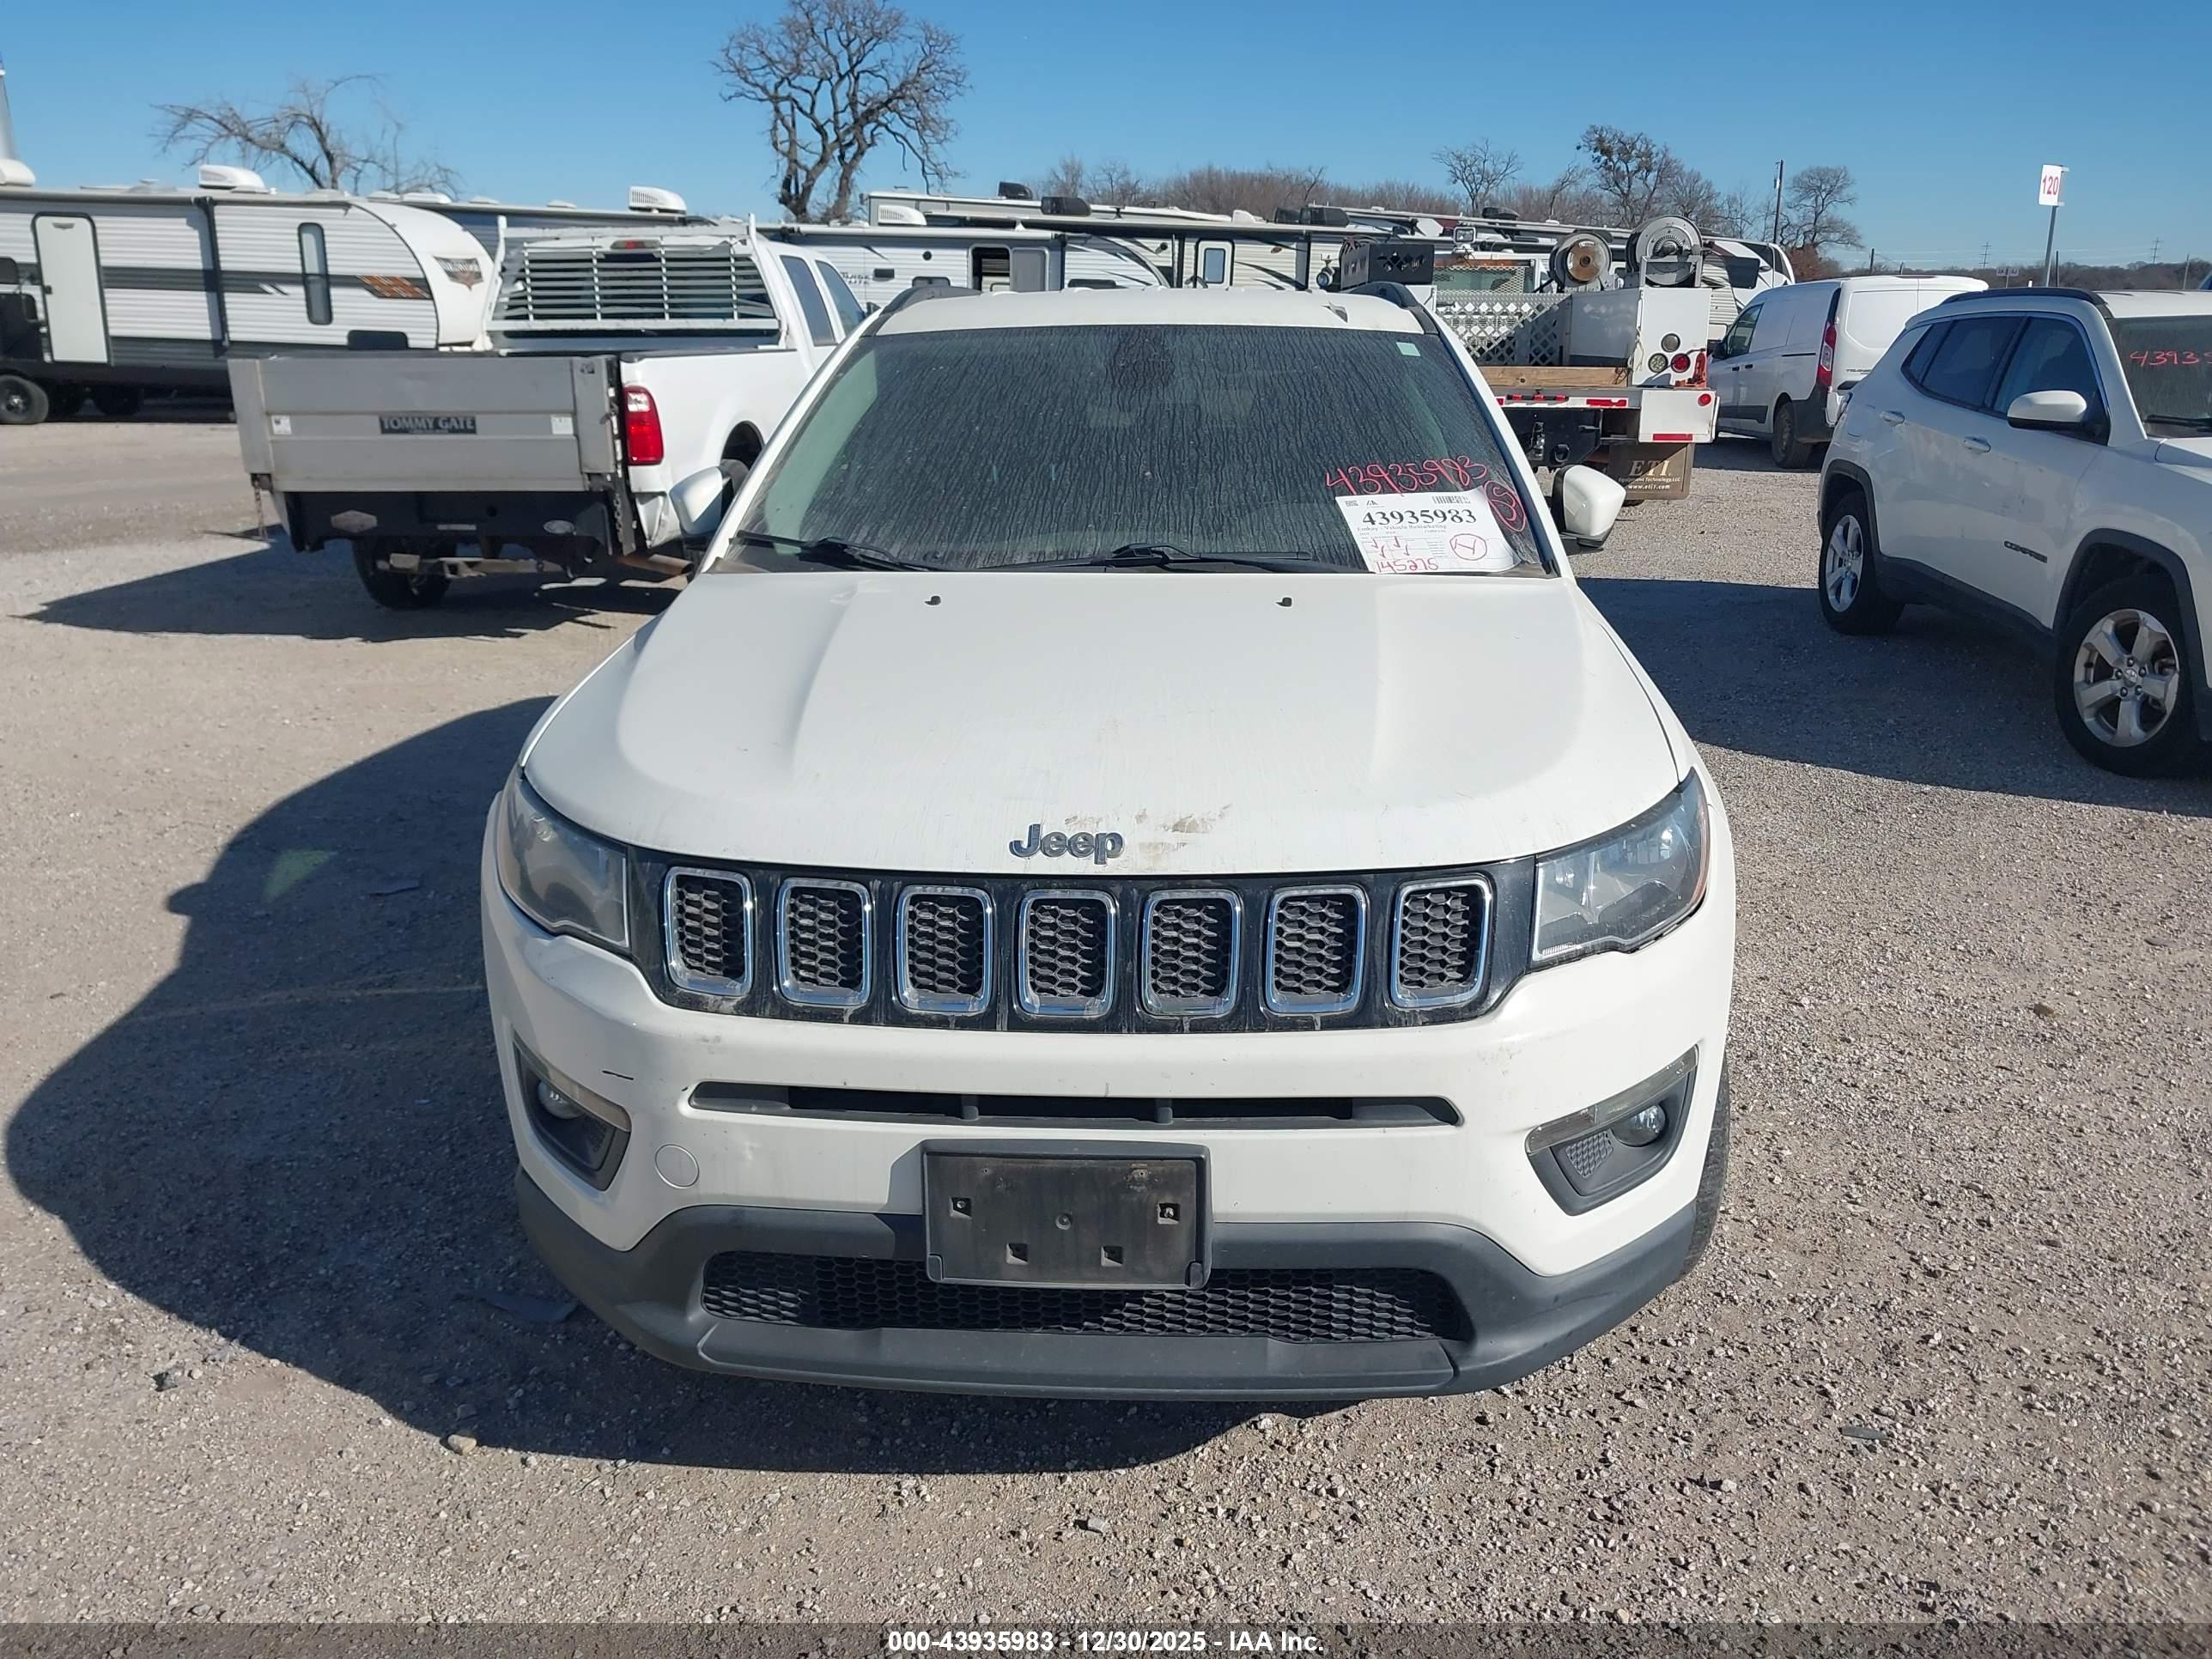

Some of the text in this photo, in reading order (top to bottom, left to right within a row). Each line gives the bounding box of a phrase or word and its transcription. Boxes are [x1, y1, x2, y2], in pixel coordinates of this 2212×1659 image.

[2042, 174, 2059, 195] 120
[384, 417, 475, 429] TOMMY GATE
[1326, 455, 1487, 495] 43935983
[1629, 459, 1670, 477] ETI
[1362, 508, 1477, 526] 43935983
[1376, 557, 1439, 574] 145275
[1008, 823, 1125, 866] Jeep
